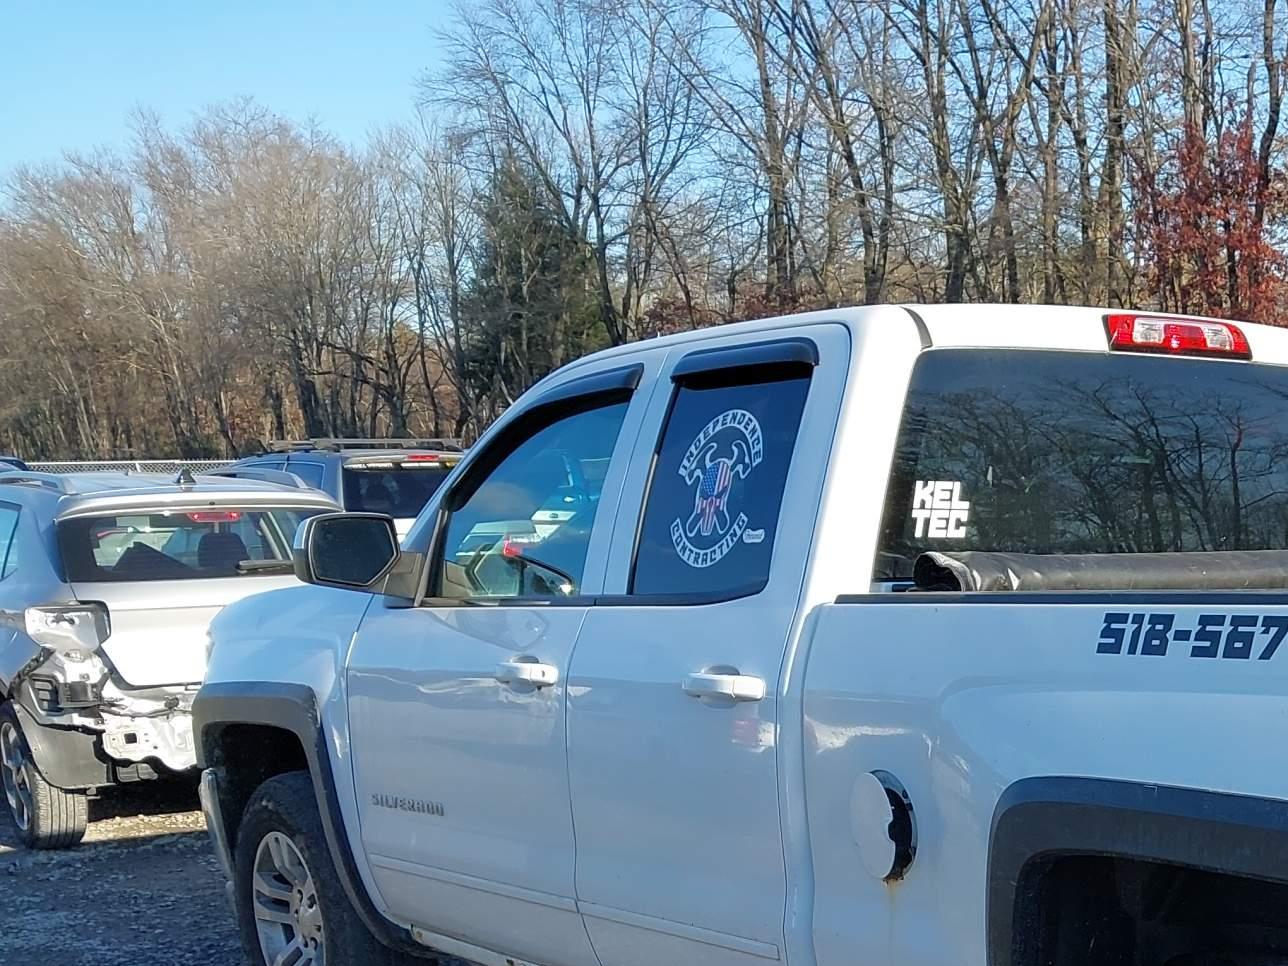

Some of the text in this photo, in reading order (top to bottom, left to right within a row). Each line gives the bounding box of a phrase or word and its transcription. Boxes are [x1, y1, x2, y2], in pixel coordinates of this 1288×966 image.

[679, 410, 763, 474] INDEPENDENCE
[912, 480, 970, 510] KEL
[911, 509, 969, 538] TEC
[671, 513, 748, 566] CONTRACTING
[371, 793, 445, 817] SILVERADO
